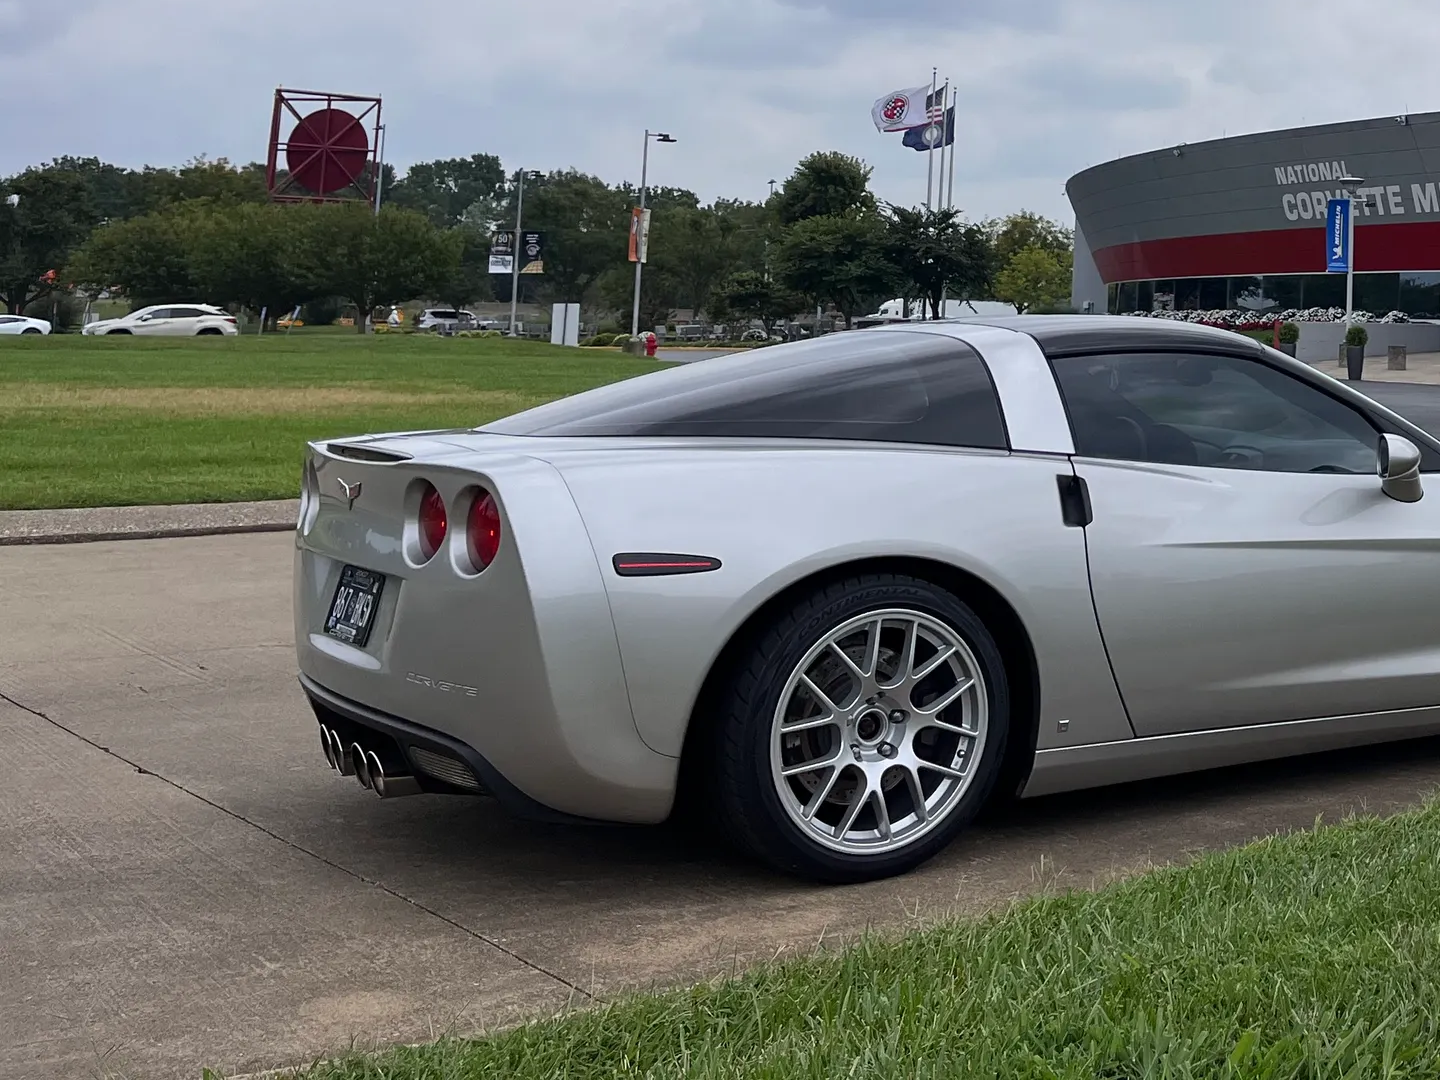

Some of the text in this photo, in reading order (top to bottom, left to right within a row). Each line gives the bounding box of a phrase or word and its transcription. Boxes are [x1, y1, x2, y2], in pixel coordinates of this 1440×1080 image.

[1274, 160, 1352, 185] NATIONAL
[1334, 205, 1342, 246] MICHELIN
[798, 587, 920, 640] CONTINENTAL
[405, 671, 478, 697] CORVETTE
